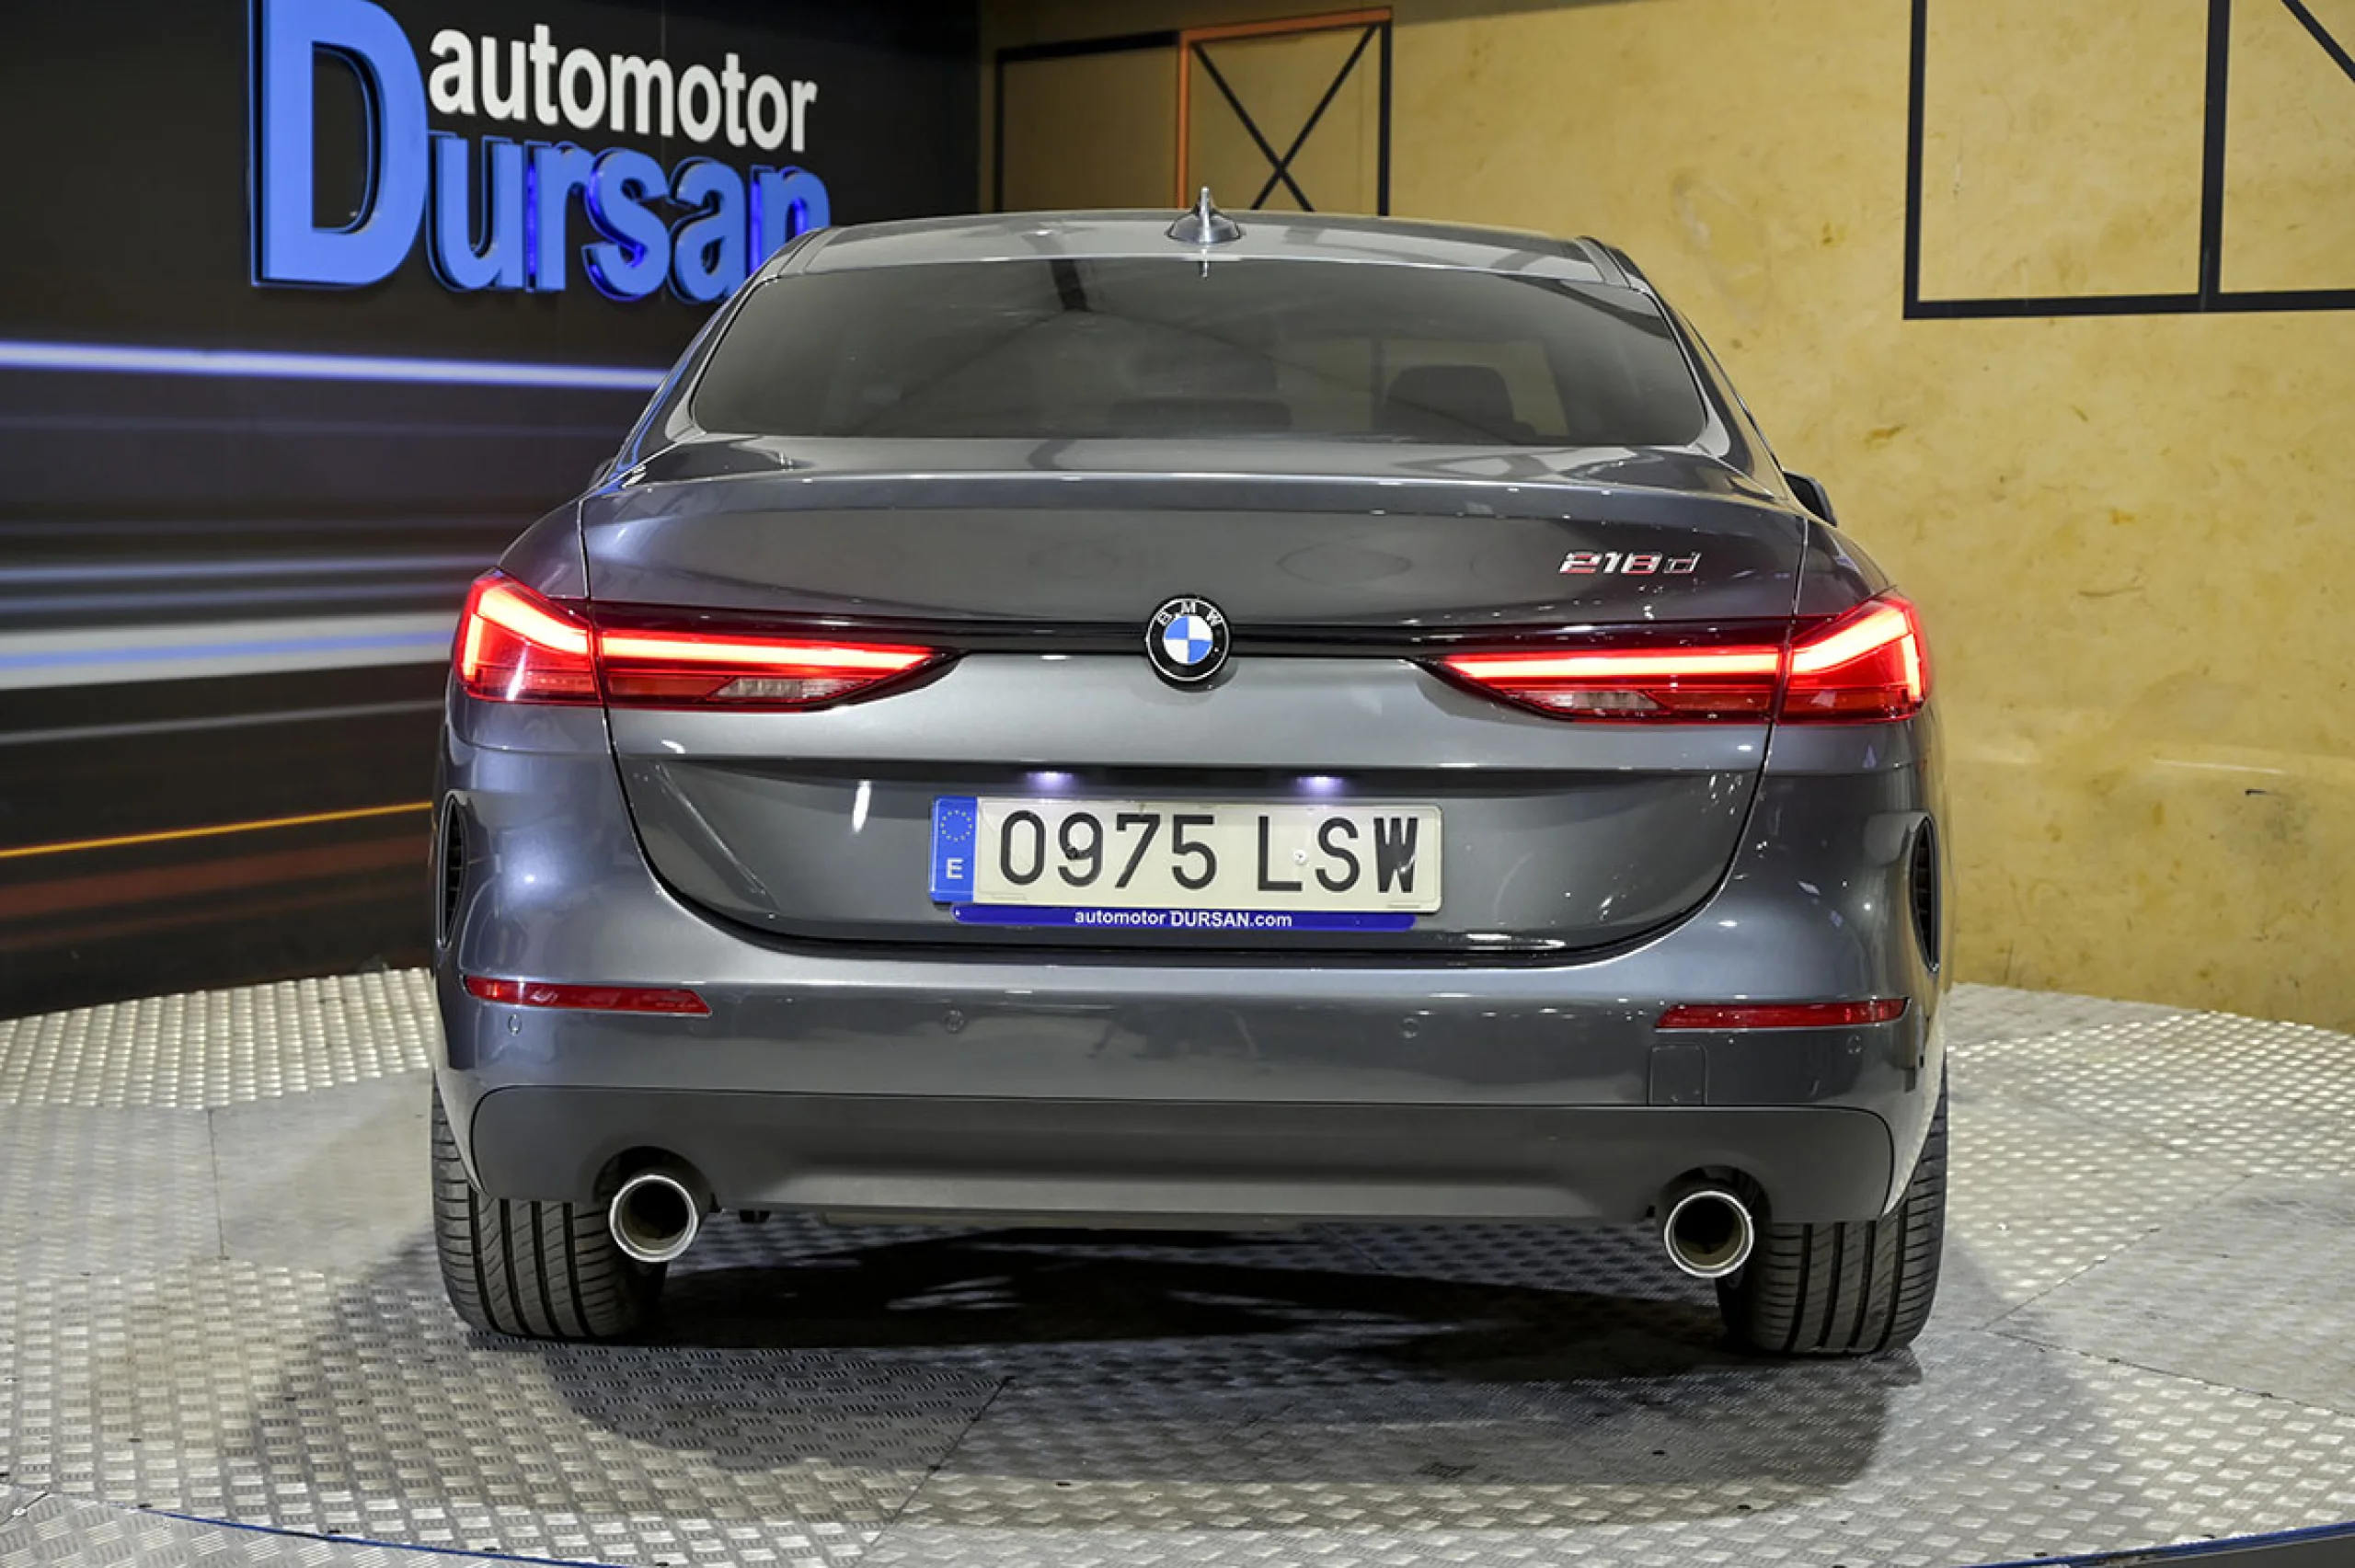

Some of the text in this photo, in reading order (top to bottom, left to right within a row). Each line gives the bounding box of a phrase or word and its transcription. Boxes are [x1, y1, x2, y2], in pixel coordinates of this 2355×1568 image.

[429, 23, 818, 152] automotor
[250, 0, 831, 303] Dursan
[1559, 552, 1702, 575] 218d
[1156, 600, 1224, 626] BMW
[999, 809, 1419, 894] 0975 LSW
[946, 858, 963, 880] E
[1074, 910, 1292, 928] automotor DURSAN.com
